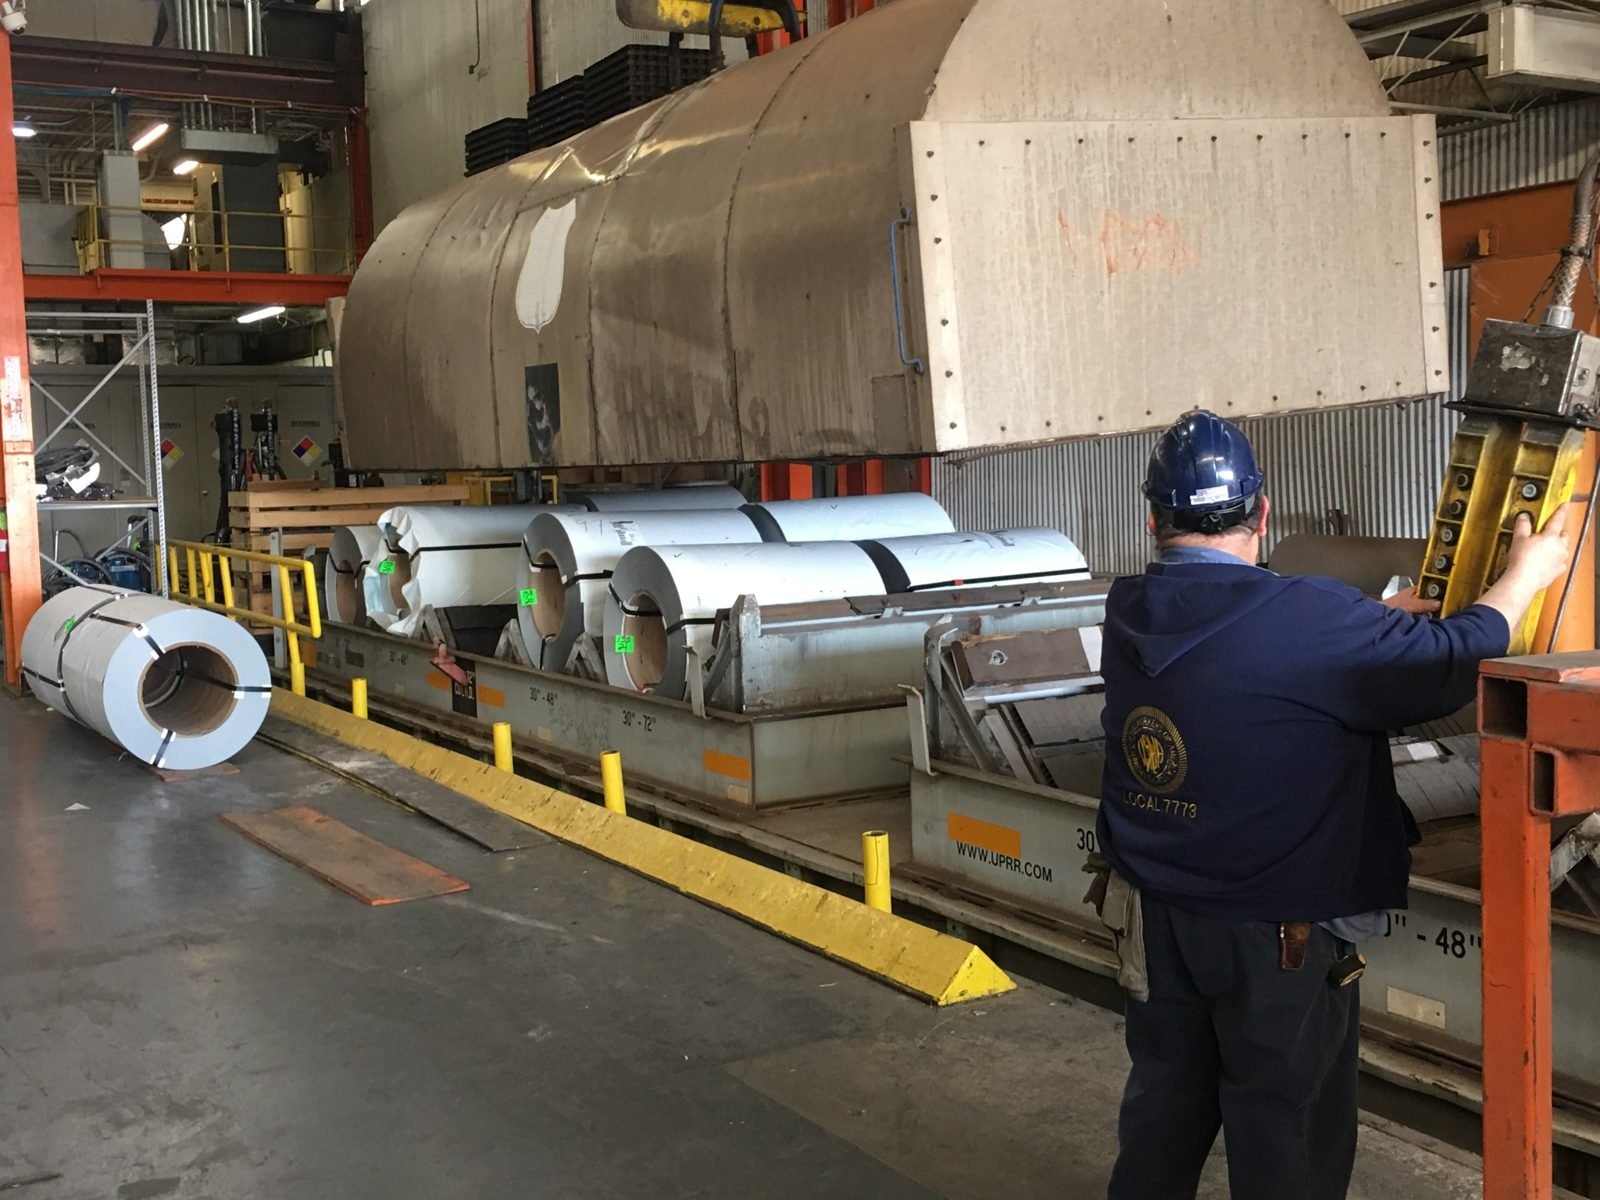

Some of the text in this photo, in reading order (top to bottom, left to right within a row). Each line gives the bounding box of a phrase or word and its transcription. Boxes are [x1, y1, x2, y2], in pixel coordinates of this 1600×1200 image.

[622, 710, 635, 726] 30"
[643, 714, 657, 732] 72"
[1123, 790, 1198, 819] LOCAL 7773
[956, 840, 1053, 883] WWW.UPRR.COM
